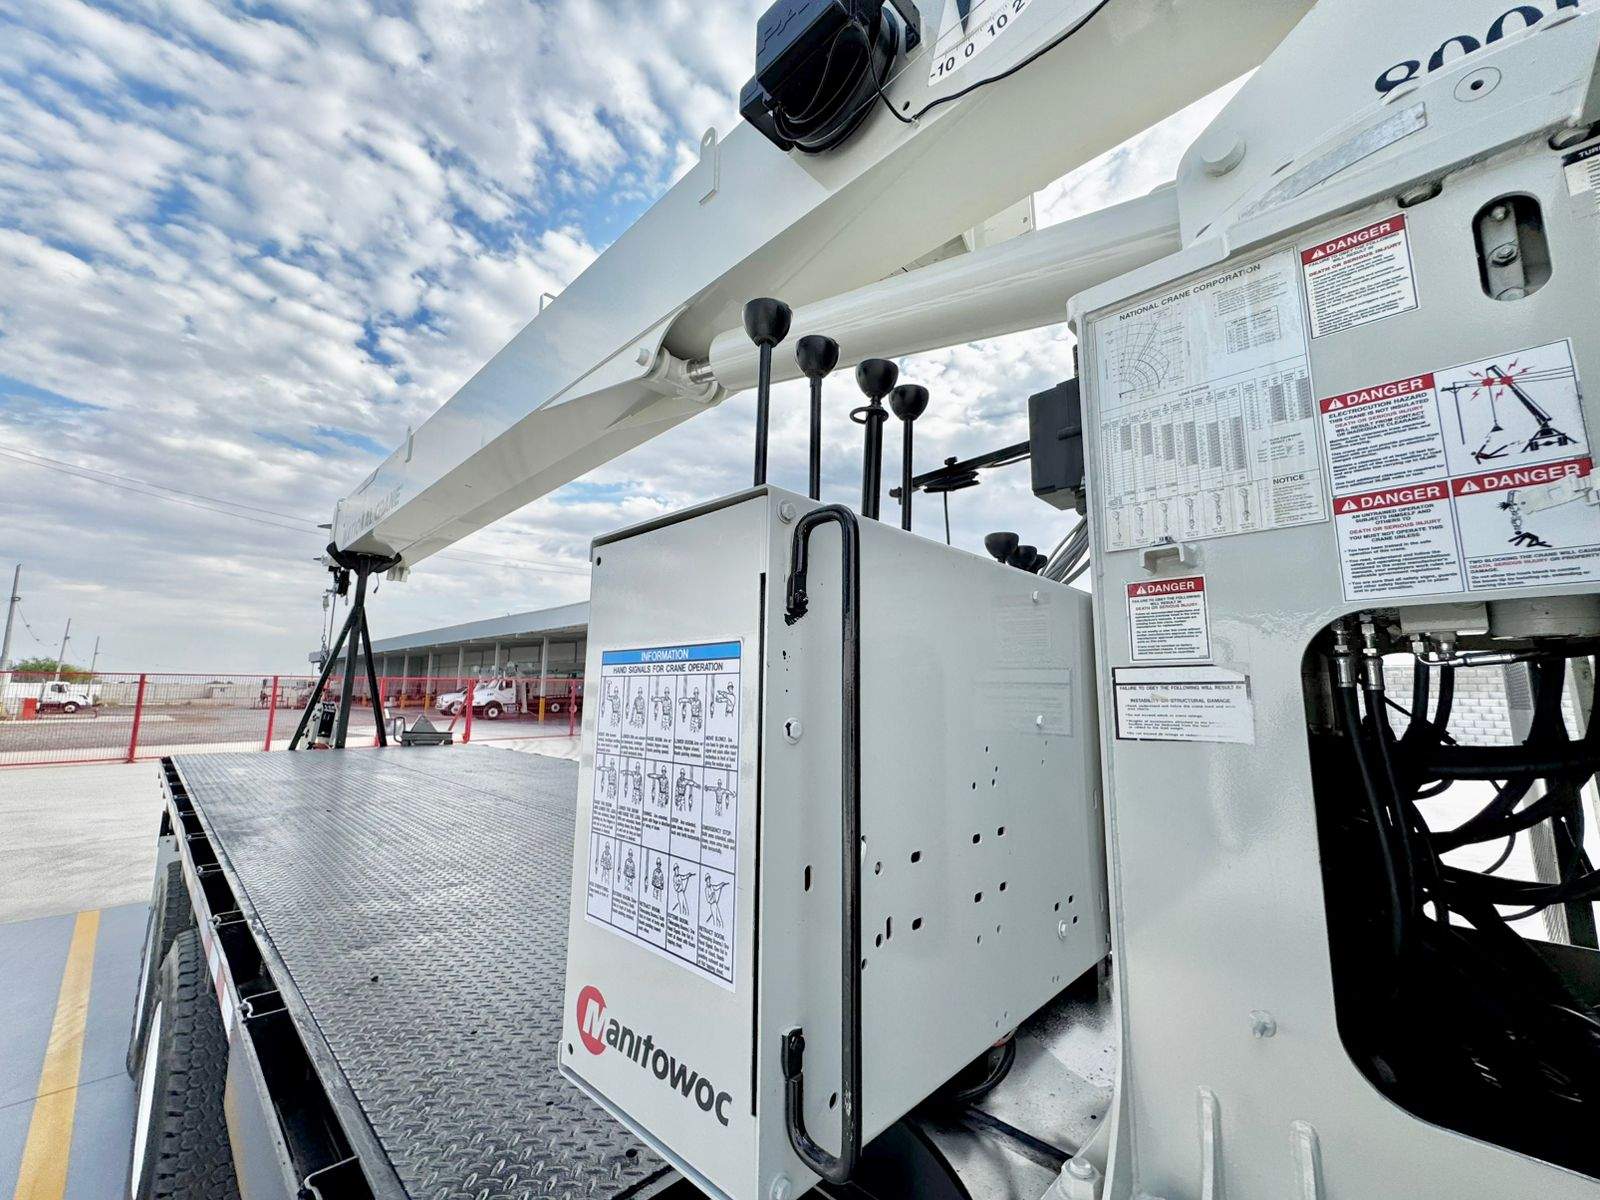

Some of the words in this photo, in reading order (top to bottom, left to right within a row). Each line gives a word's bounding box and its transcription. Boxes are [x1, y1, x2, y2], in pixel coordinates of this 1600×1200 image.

[986, 14, 1008, 37] 10
[964, 42, 975, 57] 0
[930, 56, 955, 78] -10
[1326, 223, 1391, 253] DANGER
[1309, 266, 1330, 277] DEATH
[1343, 252, 1373, 265] SERIOUS
[1375, 242, 1402, 254] INJURY
[1119, 303, 1159, 321] NATIONAL
[1161, 290, 1191, 305] CRANE
[1193, 264, 1261, 292] CORPORATION
[1347, 378, 1424, 406] DANGER
[1329, 400, 1391, 419] ELECTROCUTION
[1394, 392, 1428, 404] HAZARD
[1335, 420, 1356, 428] DEATH
[1369, 411, 1397, 421] SERIOUS
[1399, 405, 1423, 414] INJURY
[1344, 412, 1365, 421] CRANE
[1391, 398, 1429, 410] INSULATED
[1347, 424, 1385, 435] INADEQUATE
[1387, 415, 1425, 427] CLEARANCE
[1351, 422, 1373, 430] RESULT
[1394, 411, 1424, 421] CONTACT
[1273, 474, 1305, 485] NOTICE
[1486, 465, 1581, 489] DANGER
[1361, 486, 1440, 508] DANGER
[1356, 515, 1387, 523] SUBJECTS
[1362, 509, 1396, 518] UNTRAINED
[1399, 503, 1434, 512] OPERATOR
[1384, 522, 1414, 530] SERIOUS
[1416, 518, 1441, 526] INJURY
[1148, 580, 1195, 594] DANGER
[641, 649, 689, 662] INFORMATION
[629, 665, 650, 673] SIGNALS
[666, 664, 685, 672] CRANE
[688, 662, 723, 671] OPERATION
[583, 998, 732, 1126] Manitowoc
